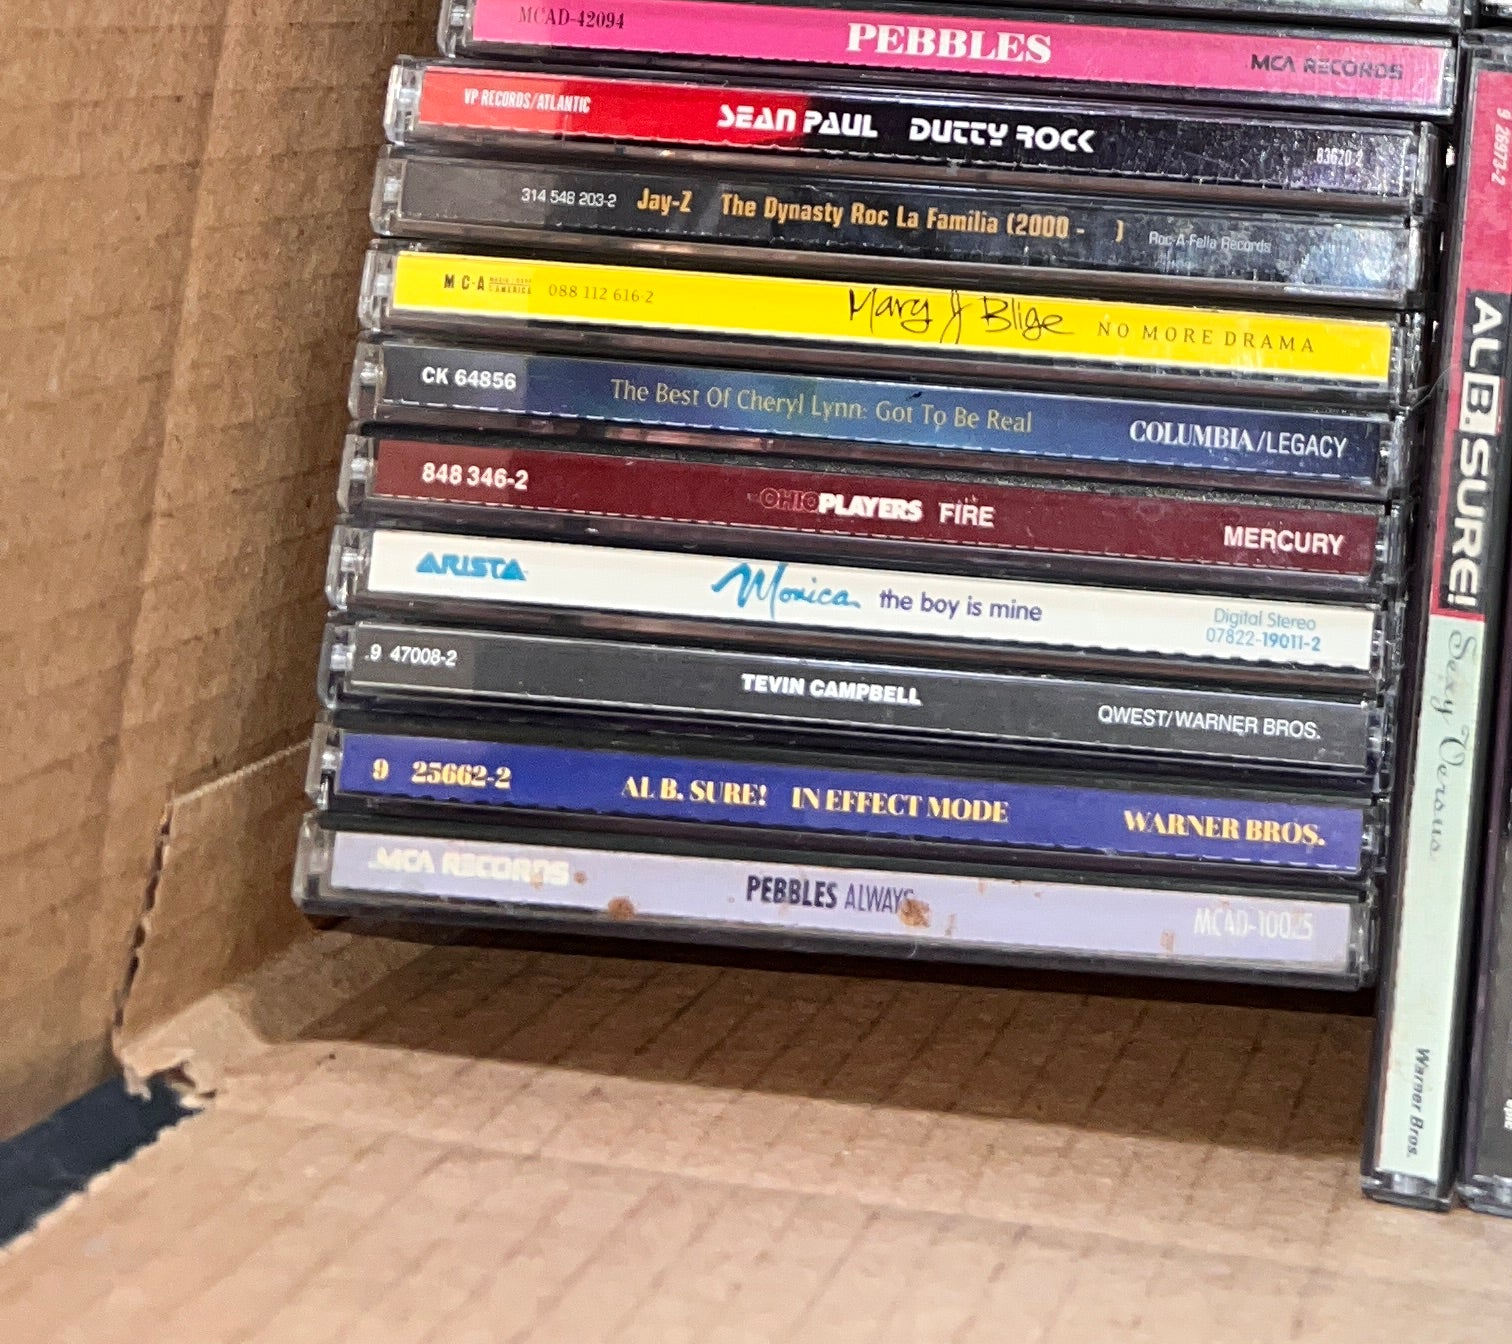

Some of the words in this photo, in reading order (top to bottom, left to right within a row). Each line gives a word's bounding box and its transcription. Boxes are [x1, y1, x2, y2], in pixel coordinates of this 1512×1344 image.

[846, 22, 1052, 64] PEBBLES
[717, 104, 797, 131] SEAN
[803, 110, 878, 138] PAUL
[909, 117, 1008, 147] DUTTY
[1015, 124, 1097, 153] ROCK
[521, 187, 546, 203] 314
[550, 188, 575, 204] 548
[578, 190, 617, 208] 203-2
[422, 365, 448, 385] CK
[454, 368, 516, 389] 64856
[1129, 419, 1348, 458] COLUMBIA/LEGACY
[939, 502, 995, 528] FIRE
[1223, 524, 1344, 556] MERCURY
[415, 551, 527, 581] ARISTA
[879, 588, 913, 610] the
[921, 592, 960, 619] boy
[966, 595, 983, 616] is
[988, 599, 1043, 623] mine
[1205, 628, 1321, 652] 07822-19011-2
[741, 674, 804, 696] TEVIN
[809, 679, 922, 706] CAMPBELL
[1262, 718, 1321, 740] BROS.
[1123, 809, 1240, 839] WARNER
[1246, 815, 1327, 846] BROS.
[746, 874, 838, 910] PEBBLES
